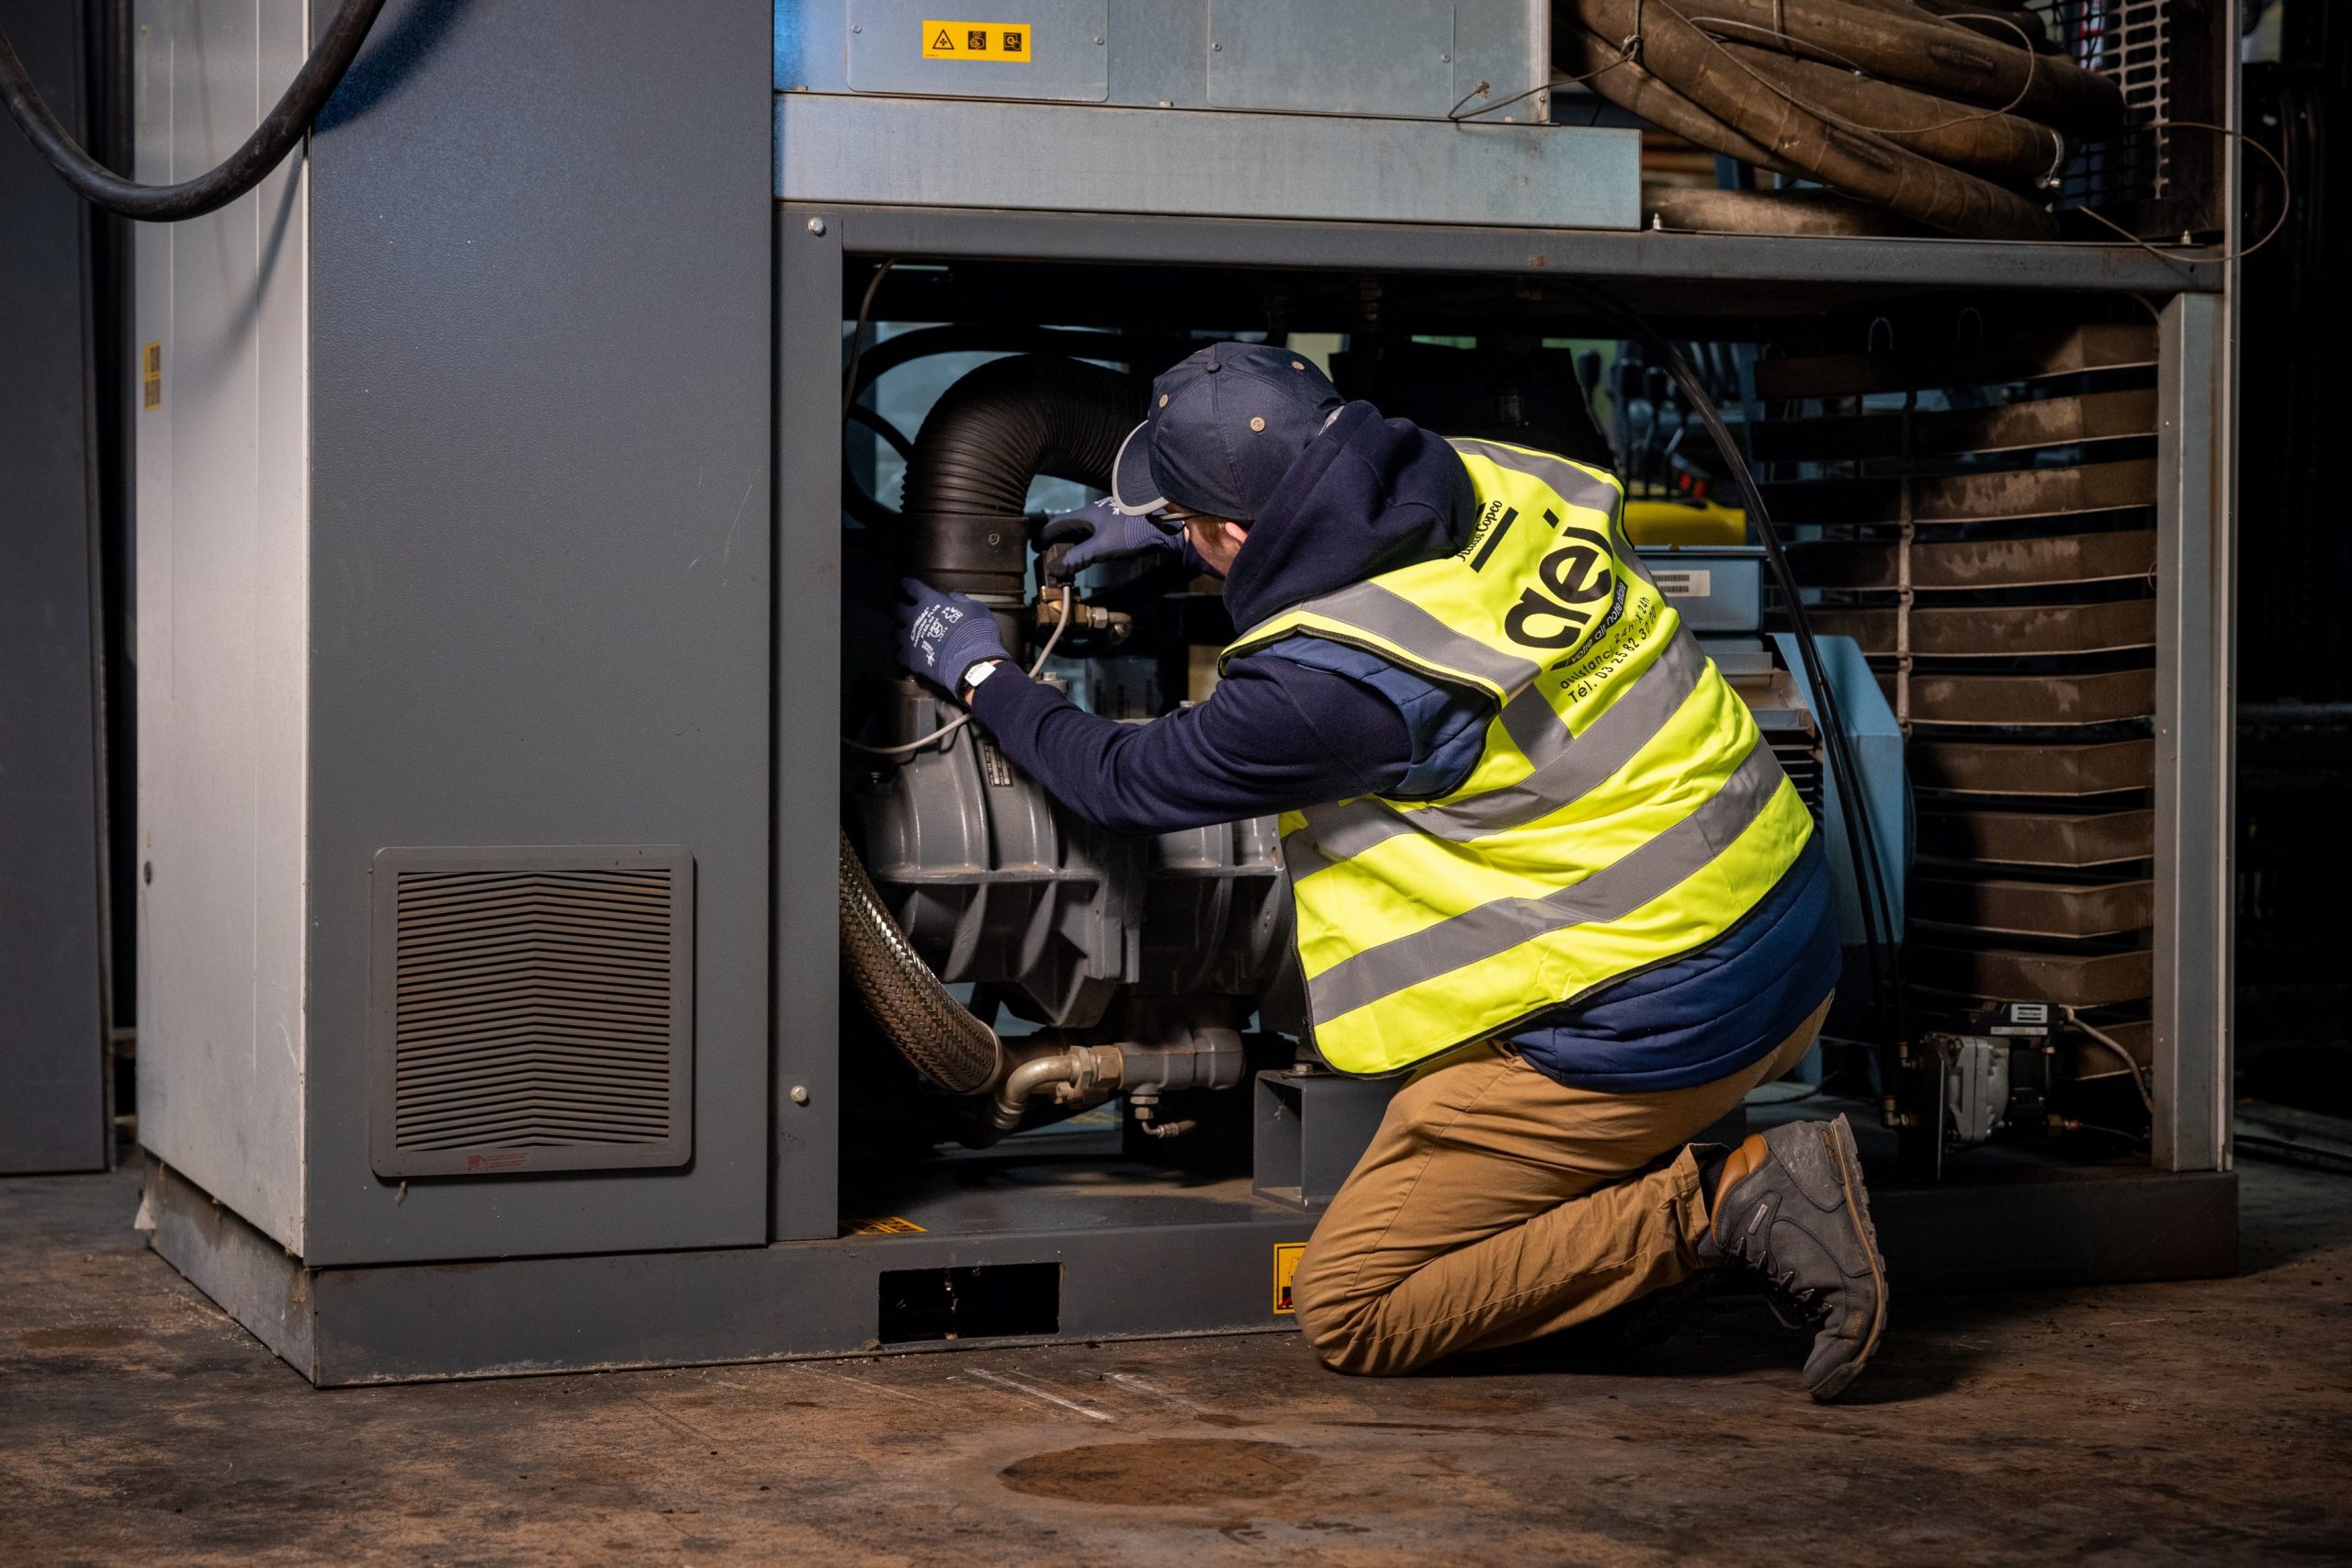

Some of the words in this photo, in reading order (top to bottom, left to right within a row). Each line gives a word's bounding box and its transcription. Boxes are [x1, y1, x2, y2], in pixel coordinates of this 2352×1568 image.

[1476, 501, 1503, 532] Copco
[1638, 596, 1650, 615] 24h
[1571, 638, 1593, 662] votre
[1567, 680, 1598, 704] Tél.
[1595, 666, 1614, 679] 03
[1611, 650, 1628, 664] 25
[1623, 637, 1640, 651] 82
